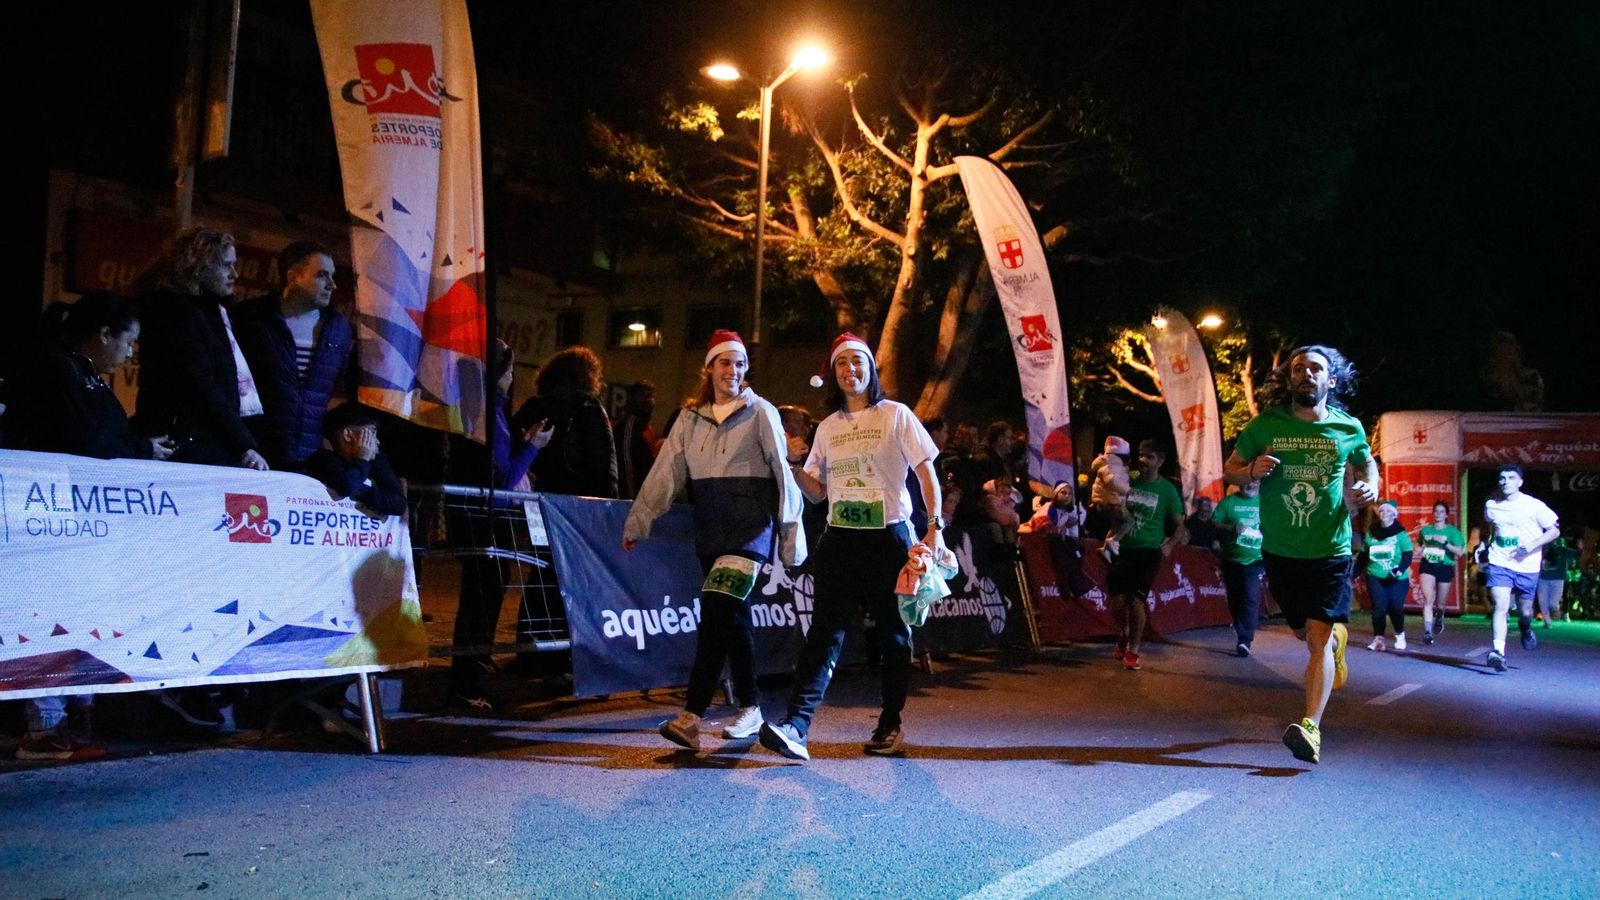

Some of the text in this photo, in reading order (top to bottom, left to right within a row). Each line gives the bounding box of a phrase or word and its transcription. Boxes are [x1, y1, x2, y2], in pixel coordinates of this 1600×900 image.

[23, 482, 179, 517] ALMERÍA
[286, 496, 336, 507] PATRONATO
[288, 510, 380, 531] DEPORTES
[840, 507, 872, 522] 451
[26, 517, 109, 538] CIUDAD
[290, 528, 315, 546] DE
[712, 574, 746, 591] 452
